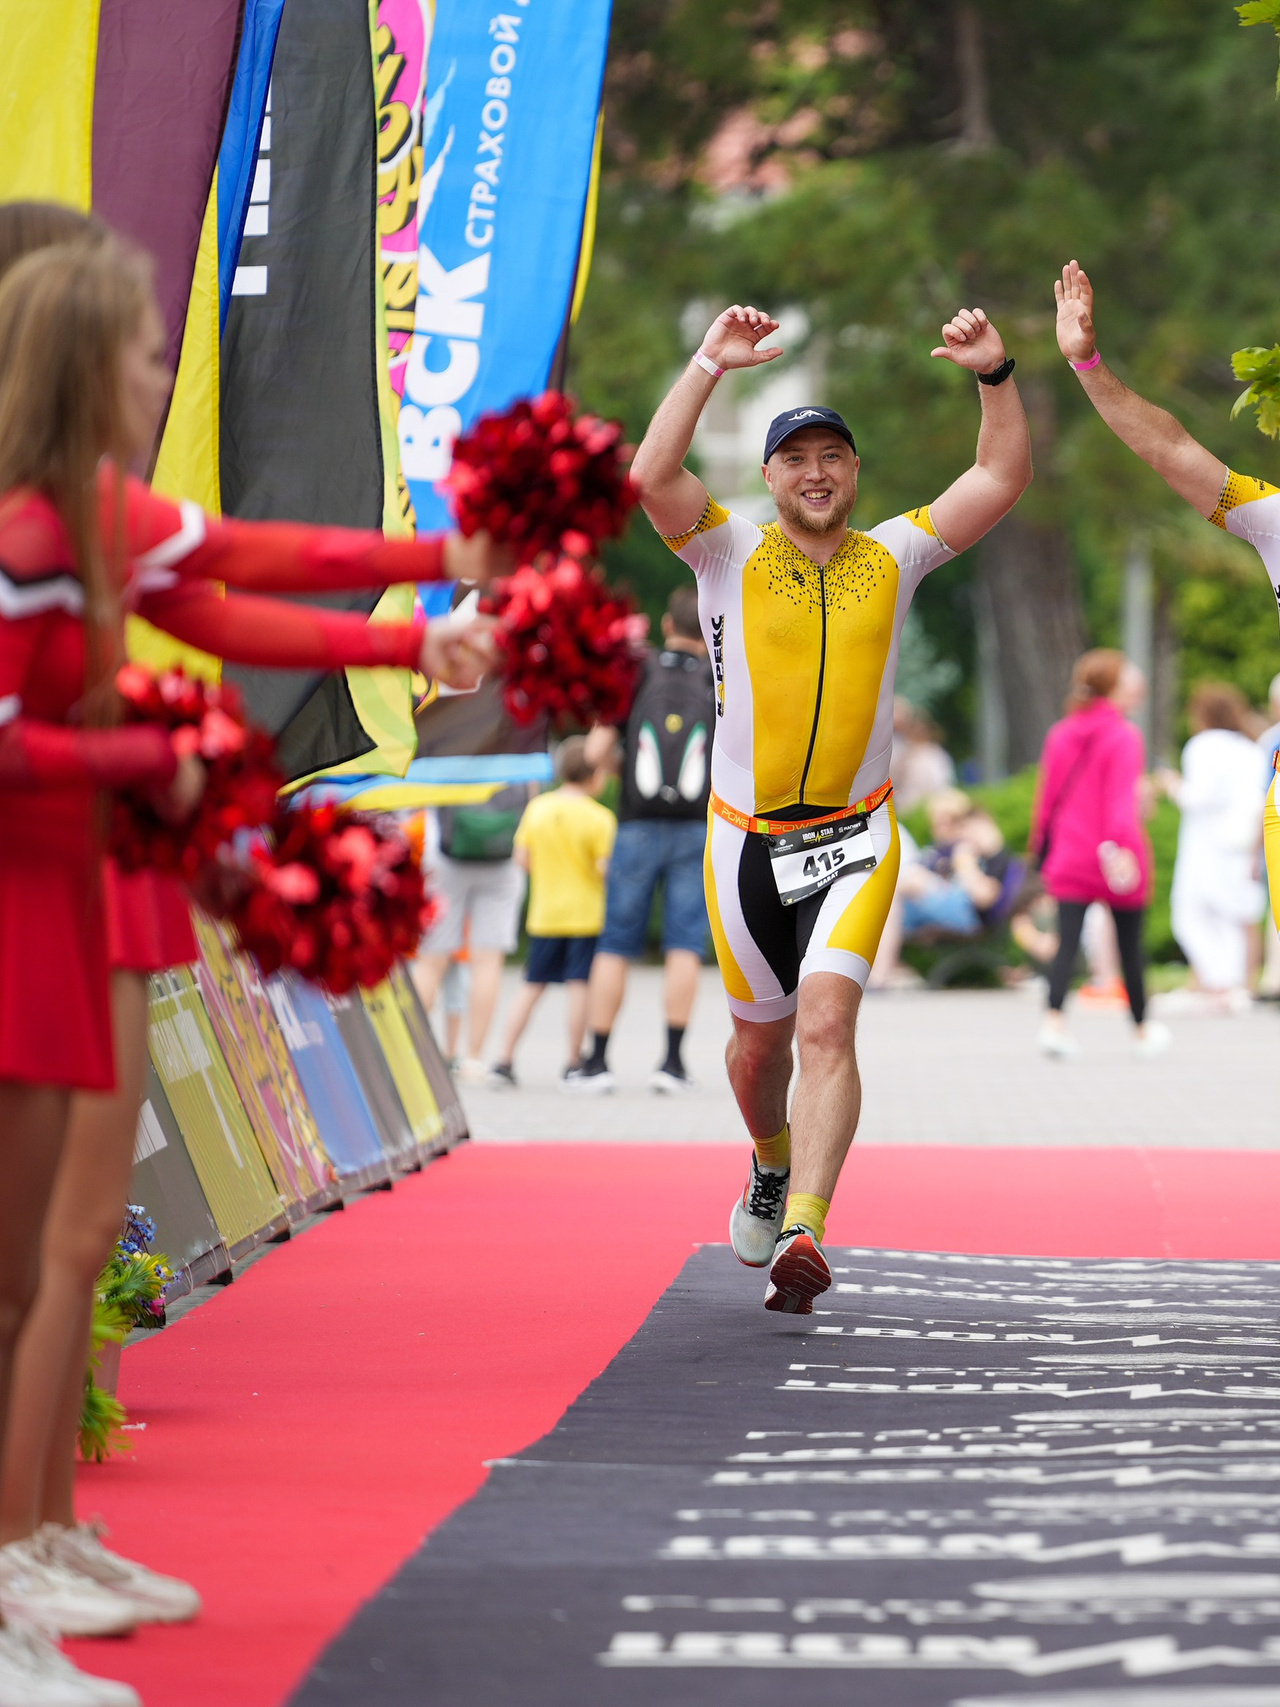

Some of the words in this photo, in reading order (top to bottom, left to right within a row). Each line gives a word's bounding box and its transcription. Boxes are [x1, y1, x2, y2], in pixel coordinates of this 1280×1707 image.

[397, 243, 492, 481] ВСК
[464, 14, 522, 248] СТРАХОВОЙ
[820, 827, 834, 836] STAR
[802, 847, 846, 878] 415
[817, 871, 839, 888] MARAT
[812, 1326, 1074, 1341] IRON
[784, 1379, 1068, 1391] IRON
